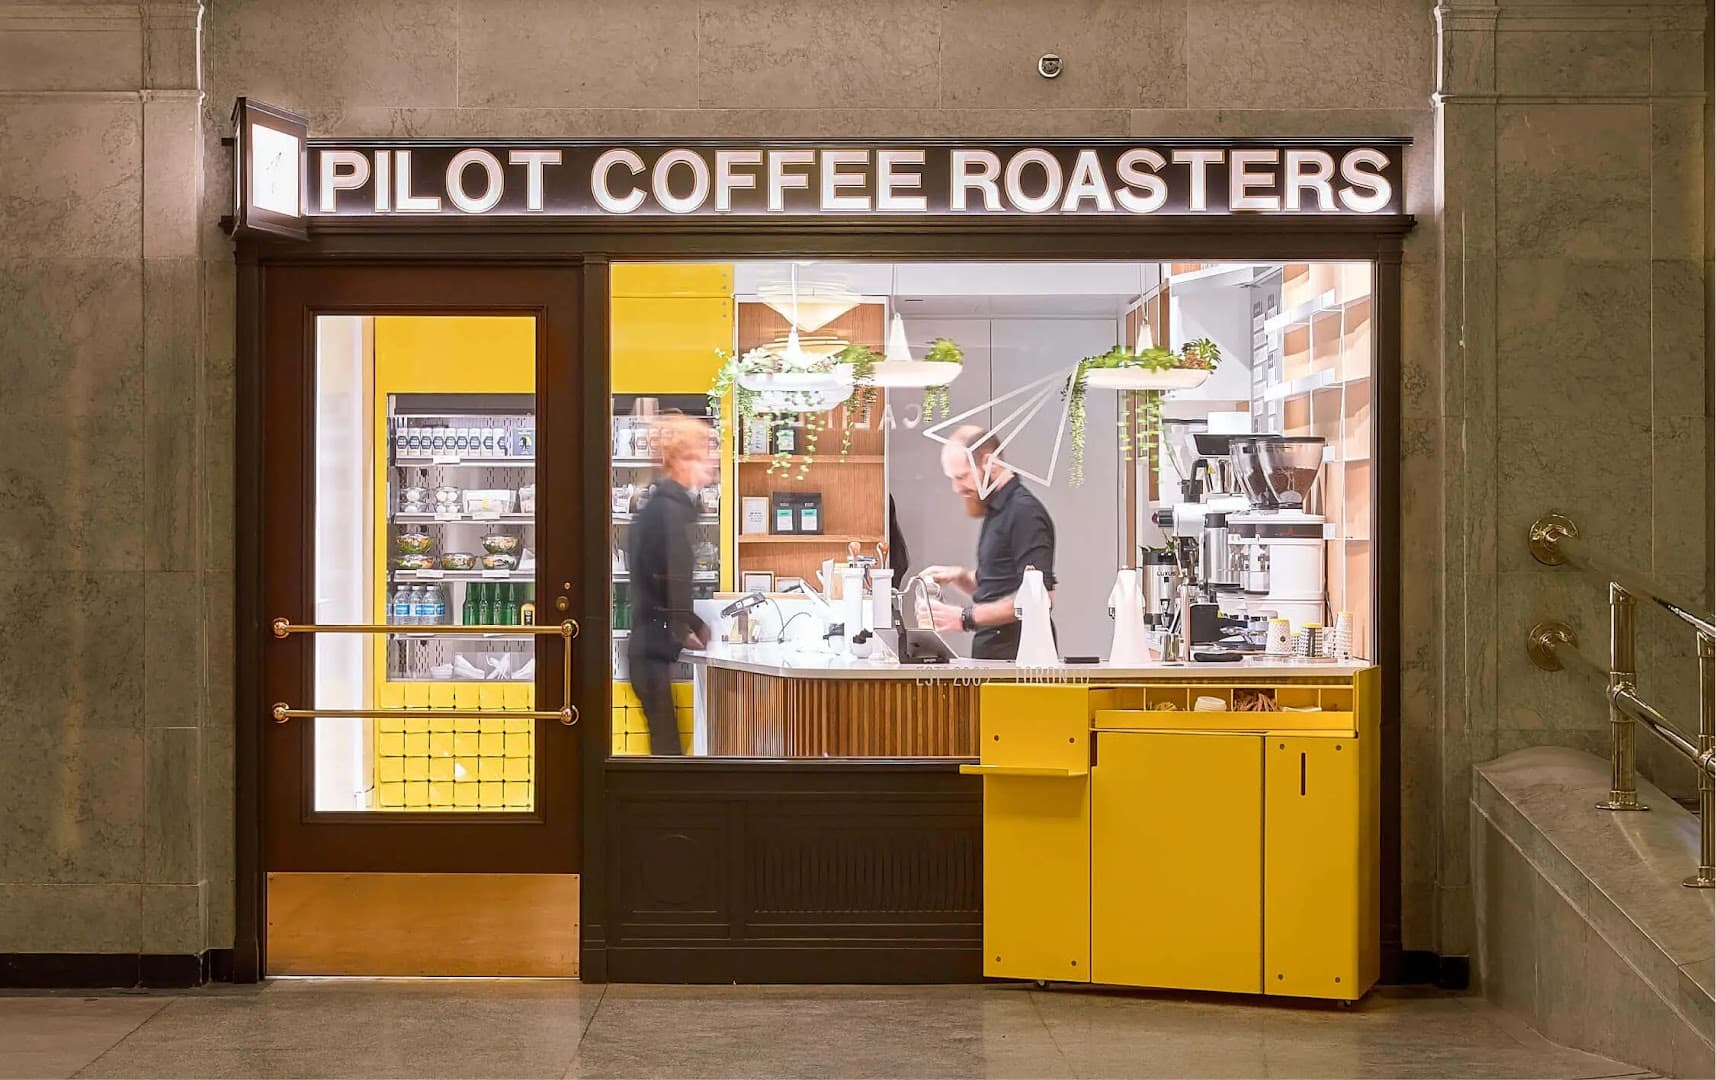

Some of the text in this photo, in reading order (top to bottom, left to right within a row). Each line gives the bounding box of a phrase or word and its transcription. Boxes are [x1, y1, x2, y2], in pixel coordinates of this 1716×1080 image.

[319, 147, 1393, 214] PILOT COFFEE ROASTERS
